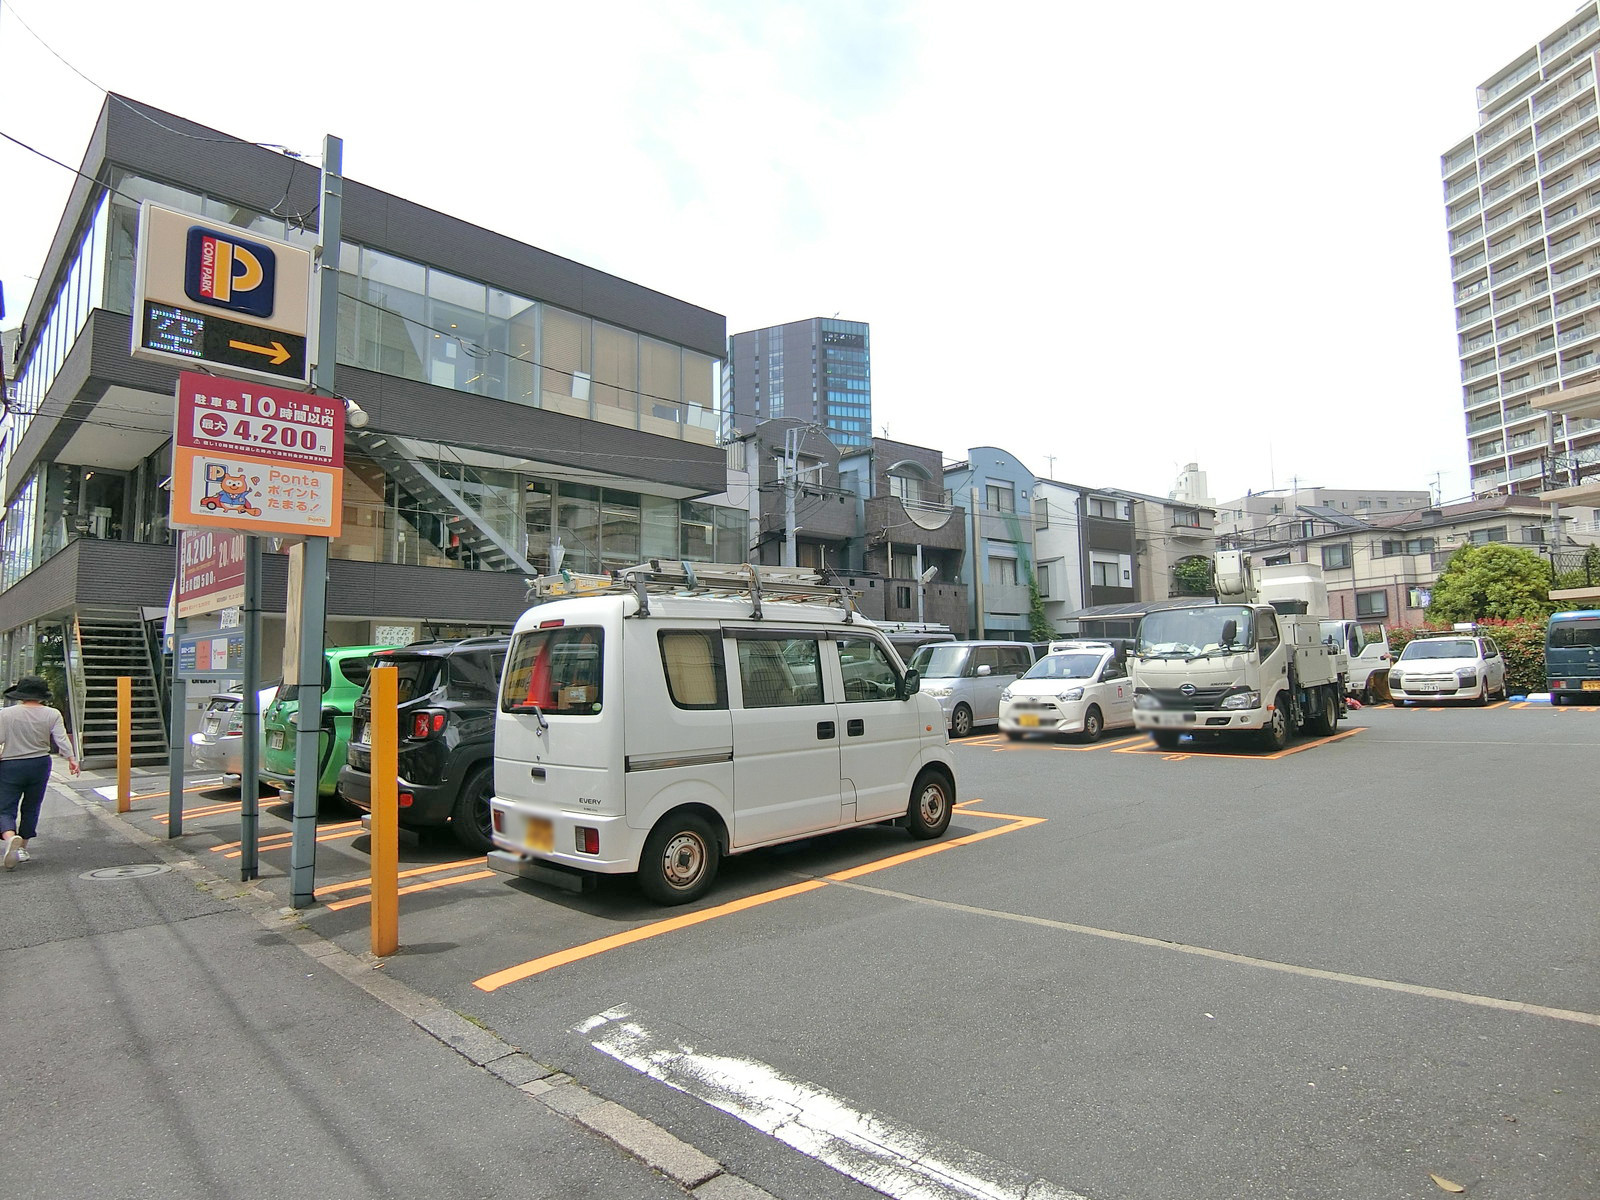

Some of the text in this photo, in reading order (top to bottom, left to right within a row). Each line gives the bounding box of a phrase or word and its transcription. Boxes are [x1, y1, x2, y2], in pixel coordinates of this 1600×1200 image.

[201, 241, 214, 293] COIN PARK
[268, 470, 320, 488] Ponta
[267, 485, 320, 499] ポイント
[579, 797, 602, 805] EVERY
